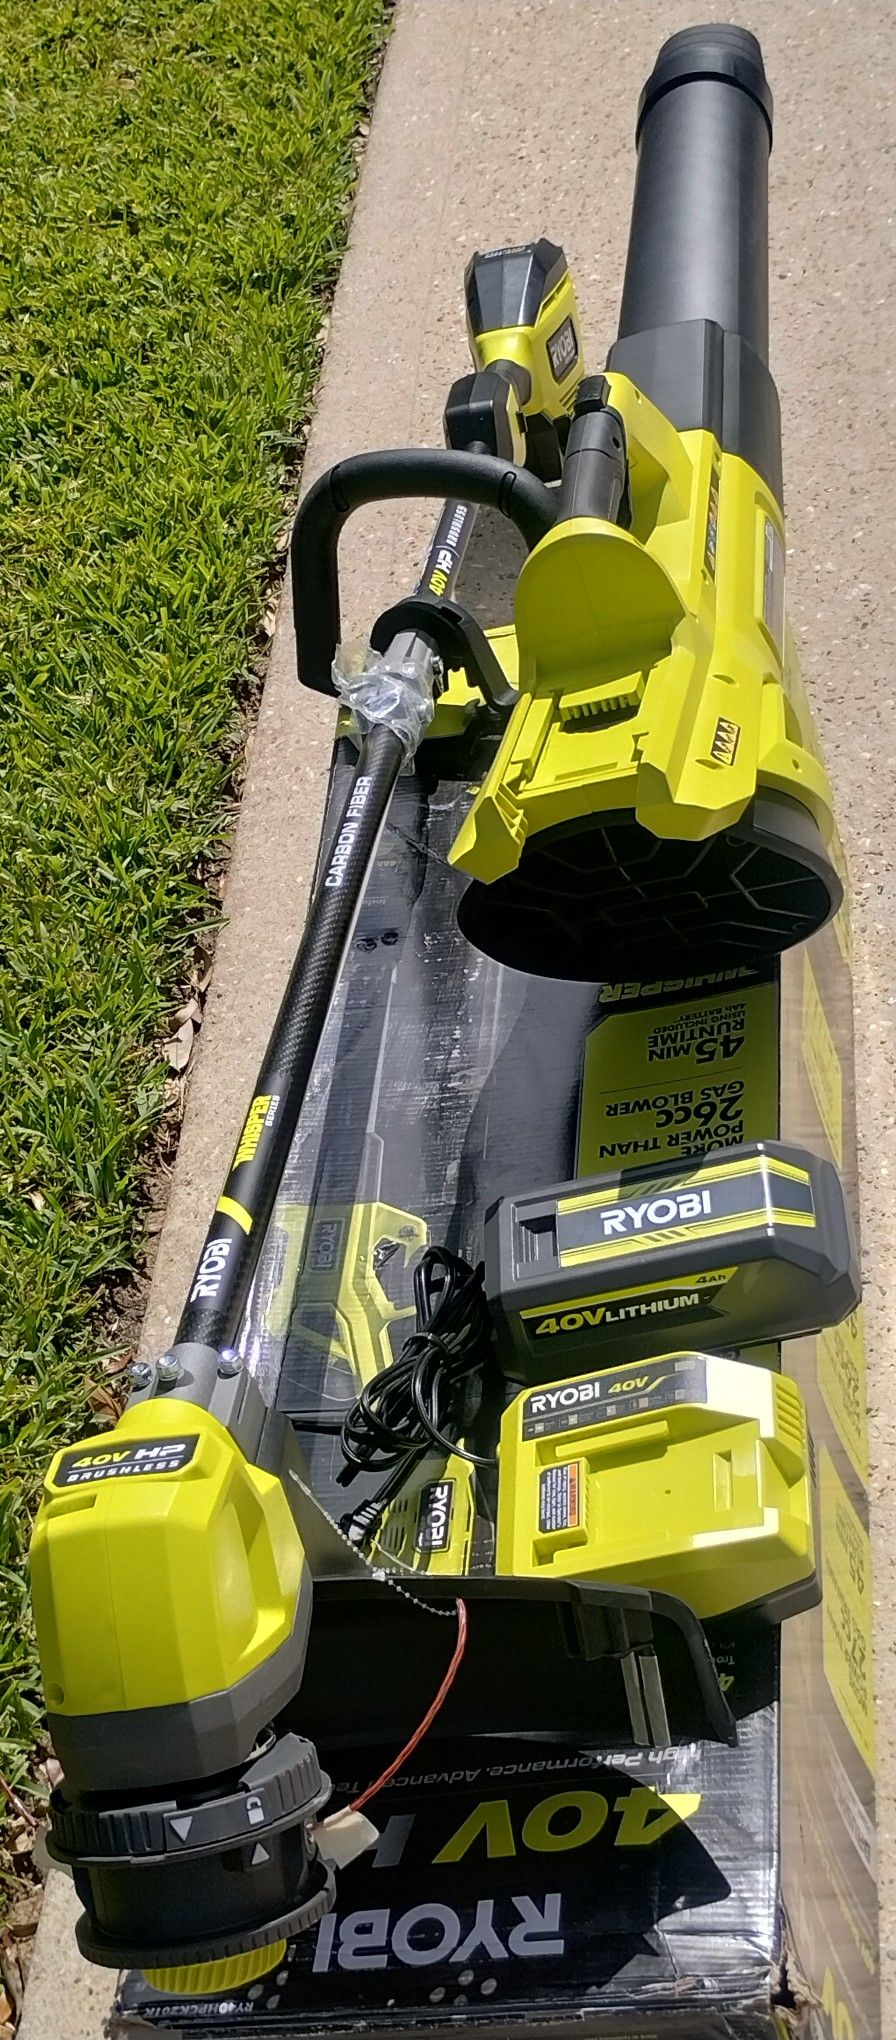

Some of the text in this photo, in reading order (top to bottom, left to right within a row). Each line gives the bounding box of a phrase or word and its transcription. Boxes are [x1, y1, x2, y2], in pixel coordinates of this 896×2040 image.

[549, 327, 575, 368] RYOBI
[429, 504, 468, 596] 40V HP BRUSHLESS
[325, 776, 373, 887] CARBON FIBER
[647, 1018, 745, 1048] RUNTIME
[653, 1010, 745, 1033] USING INCLUDED
[677, 1007, 722, 1022] BATTERY
[648, 1035, 745, 1065] 45 MIN
[265, 1095, 280, 1127] SERIES
[605, 1080, 745, 1117] GAS BLOWER
[656, 1094, 744, 1128] 26cc
[232, 1095, 272, 1171] WHISPER
[599, 1120, 744, 1159] POWER THAN
[600, 1189, 712, 1235] RYOBI
[190, 1238, 232, 1302] RYOBI
[530, 1381, 600, 1413] RYOBI
[608, 1375, 649, 1394] 40V
[66, 1459, 180, 1483] BRUSHLESS
[71, 1444, 186, 1468] 40V HP
[424, 1485, 449, 1546] RYOBI
[431, 1785, 701, 1864] 40V
[312, 1893, 564, 1973] RYOBI
